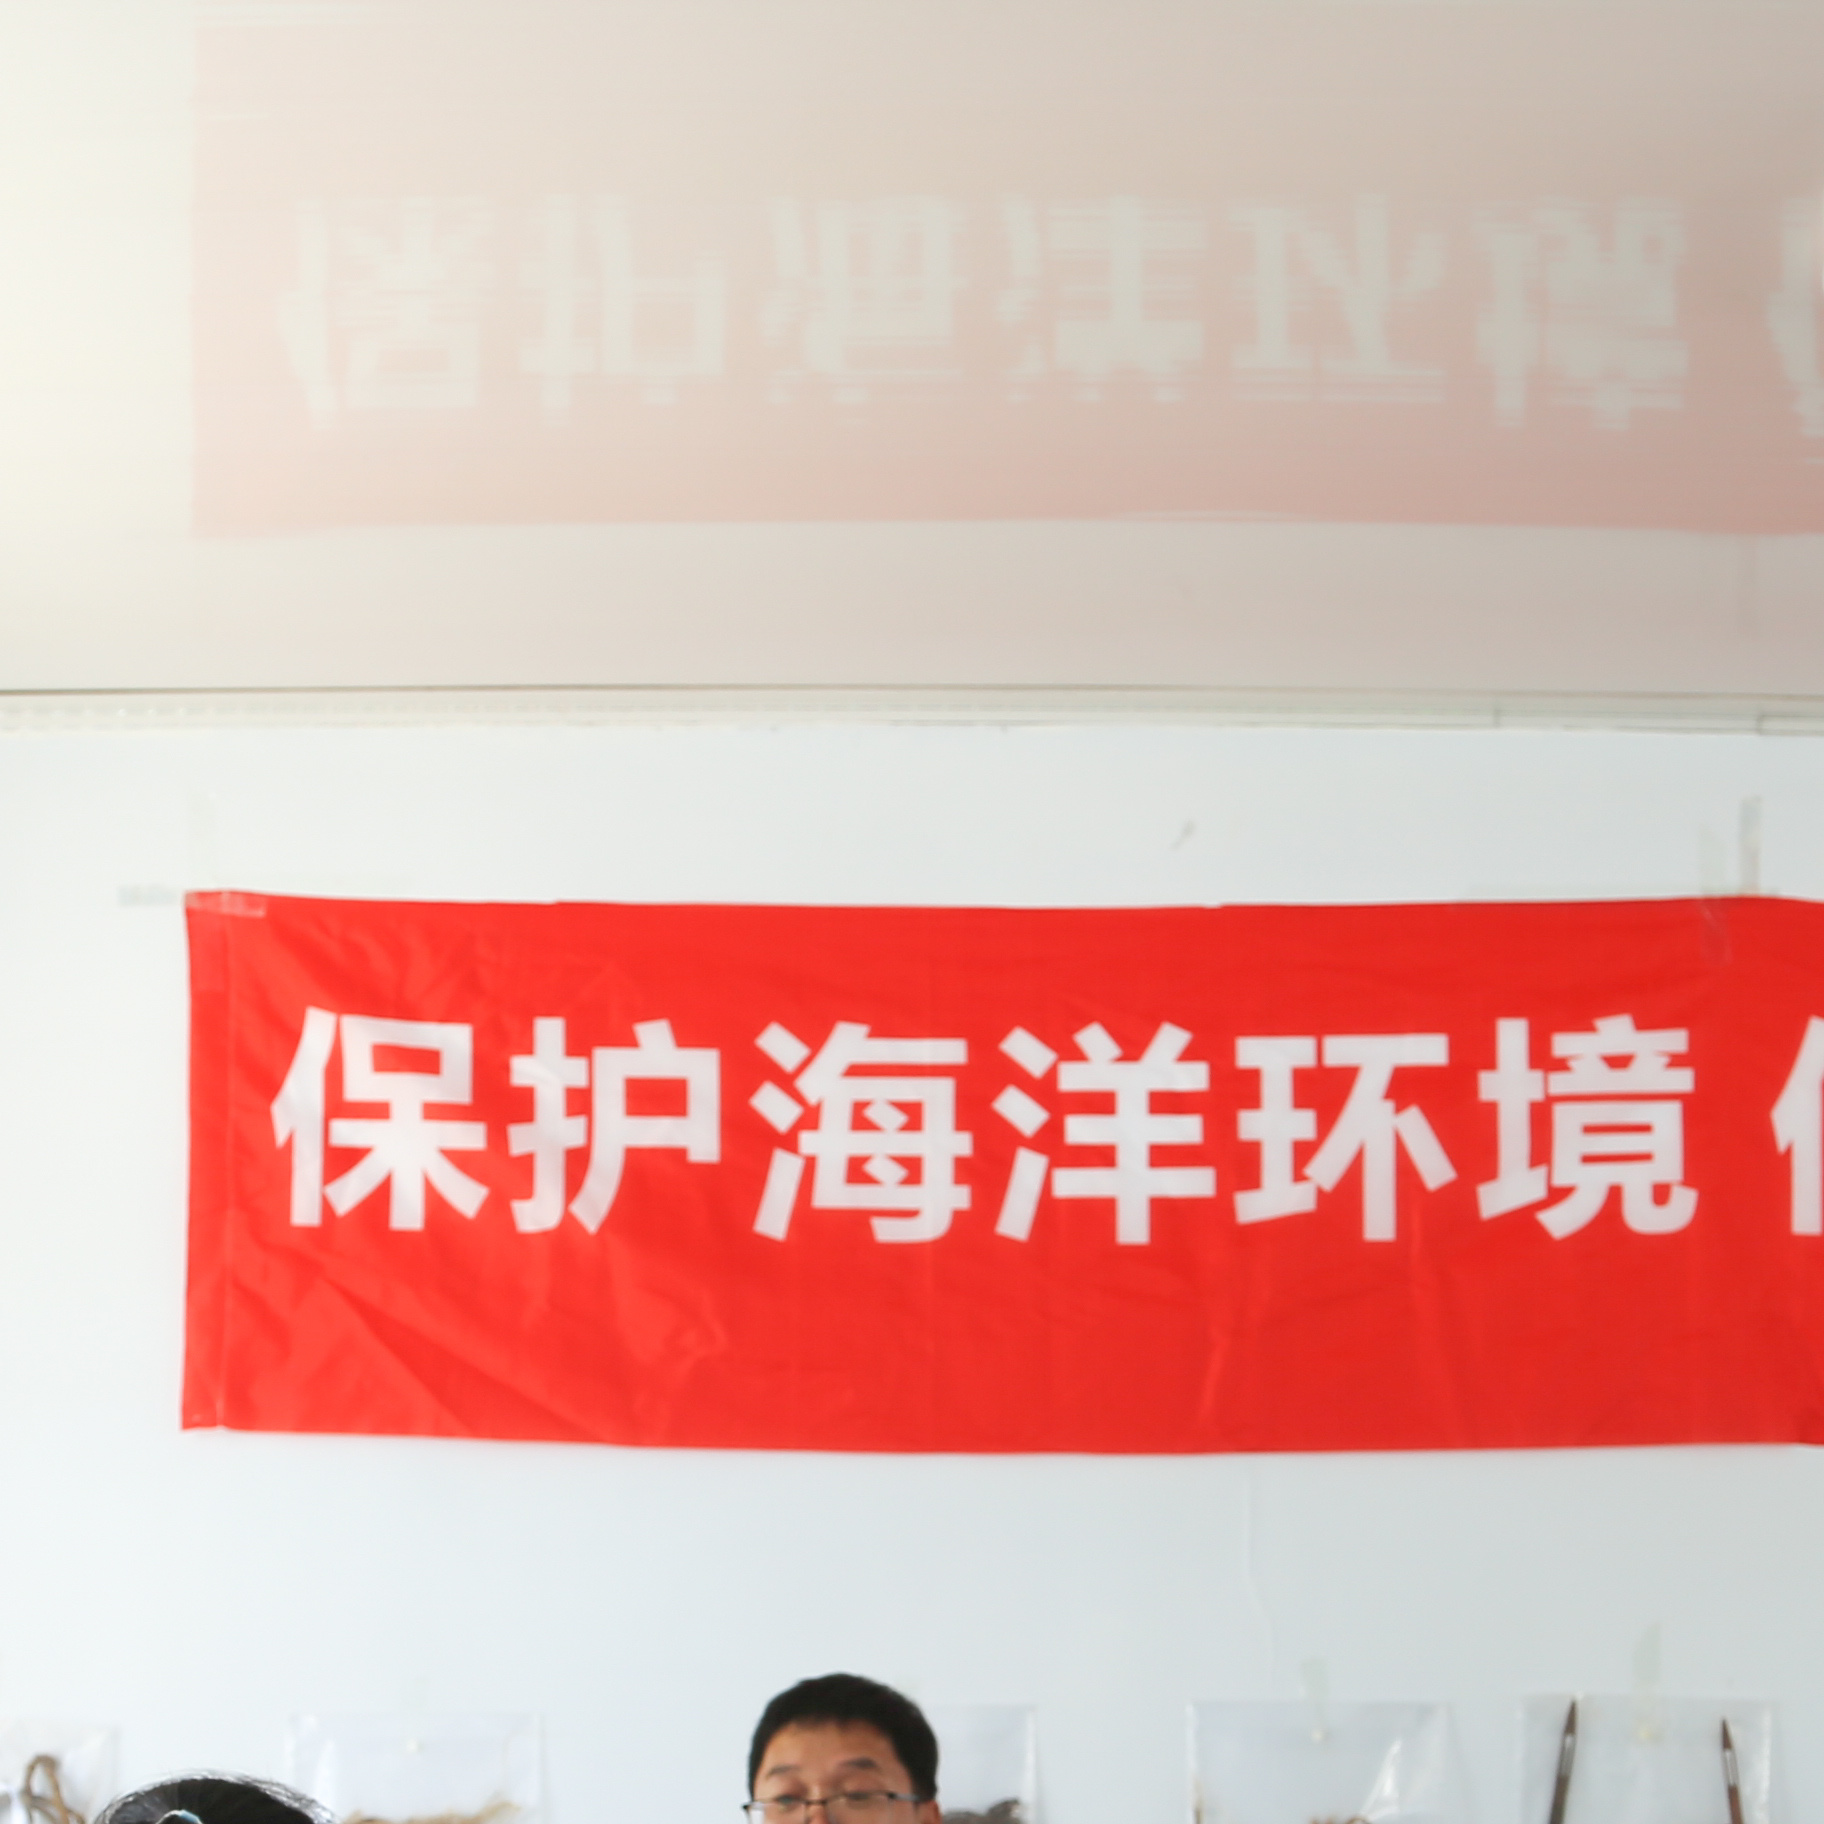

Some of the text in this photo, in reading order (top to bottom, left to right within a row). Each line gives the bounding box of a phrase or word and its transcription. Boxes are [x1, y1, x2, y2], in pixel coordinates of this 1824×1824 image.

[270, 1005, 1699, 1245] 保护海洋环境
